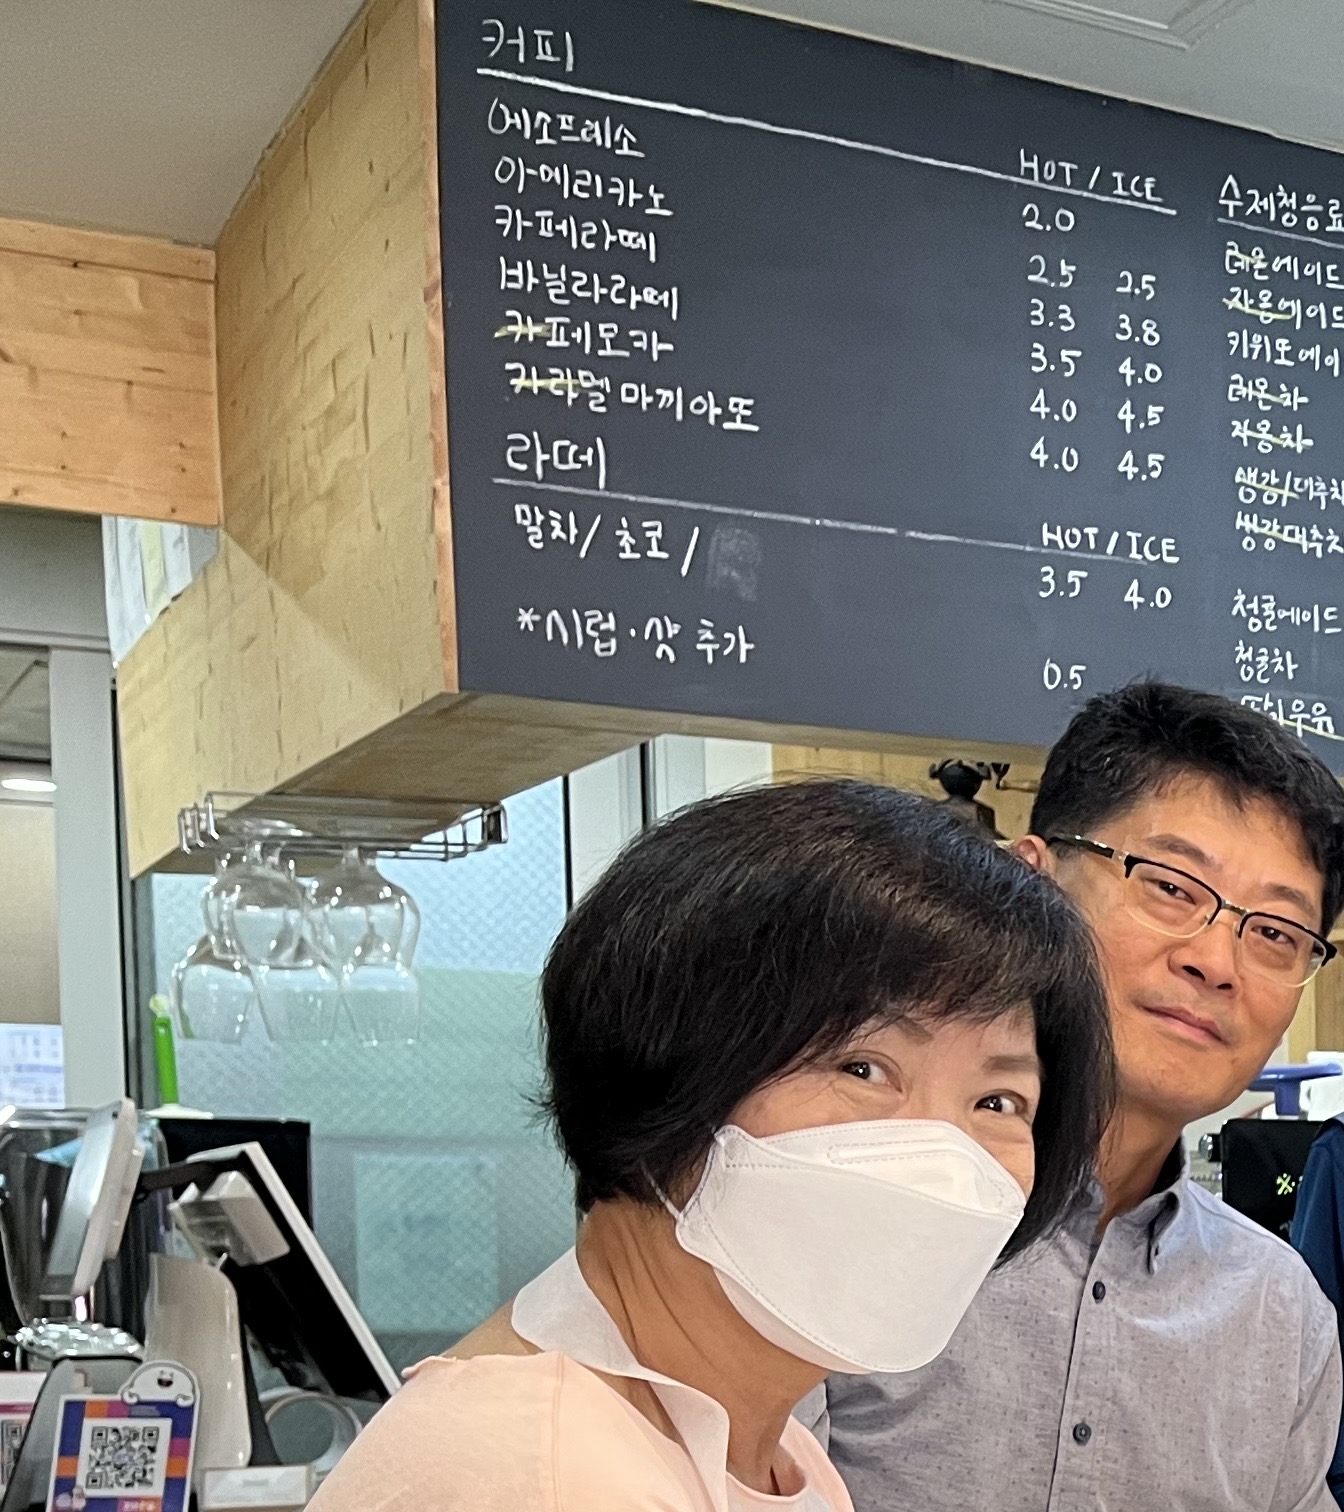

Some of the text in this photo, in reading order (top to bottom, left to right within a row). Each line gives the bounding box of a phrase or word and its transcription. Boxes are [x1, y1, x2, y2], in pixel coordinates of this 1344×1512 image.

[481, 19, 575, 71] 커피
[494, 156, 674, 216] 아메리카노
[1019, 148, 1079, 183] HOT
[1111, 171, 1164, 203] ICE
[494, 205, 657, 264] 카페라떼
[1022, 203, 1075, 232] 2.0
[499, 256, 679, 321] 바닐라라떼
[1027, 254, 1156, 300] 2.5 2.5
[505, 309, 675, 362] 카페모카
[1030, 298, 1161, 346] 3.3 3.8
[1030, 342, 1163, 387] 3.5 4.0
[504, 362, 760, 432] 카라멜 마끼아또
[1029, 388, 1164, 433] 4.0 4.5
[505, 431, 606, 491] 라떼
[1029, 436, 1165, 481] 4.0 4.5
[615, 516, 669, 559] 초코
[1041, 523, 1100, 552] HOT
[1126, 531, 1180, 564] ICE
[1038, 566, 1173, 610] 3.5 4.0
[696, 618, 755, 664] 추가
[1043, 658, 1086, 691] 0.5
